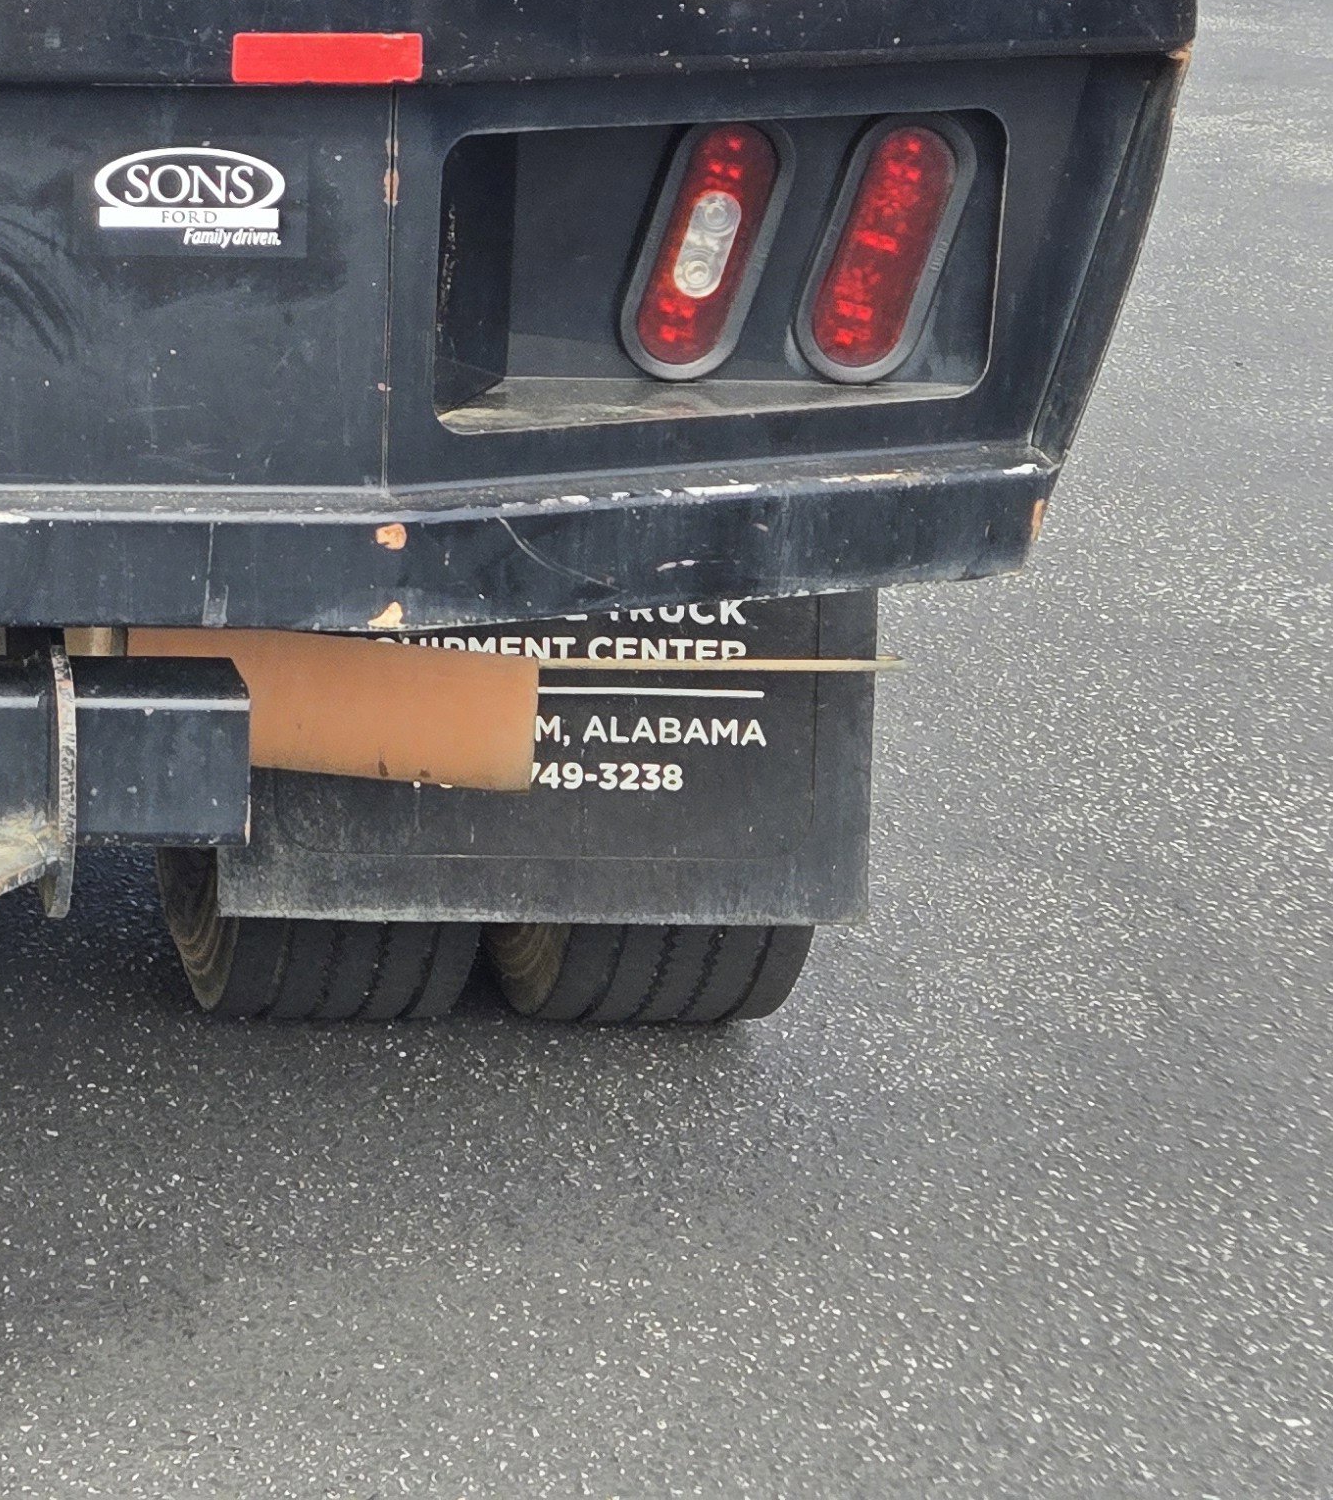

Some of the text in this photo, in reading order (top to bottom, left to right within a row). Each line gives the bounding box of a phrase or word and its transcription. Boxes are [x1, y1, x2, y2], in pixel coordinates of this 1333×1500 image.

[124, 164, 255, 204] SONS
[161, 210, 218, 224] FORD
[183, 228, 282, 248] Family driven.
[587, 636, 747, 661] CENTER
[582, 716, 767, 747] ALABAMA
